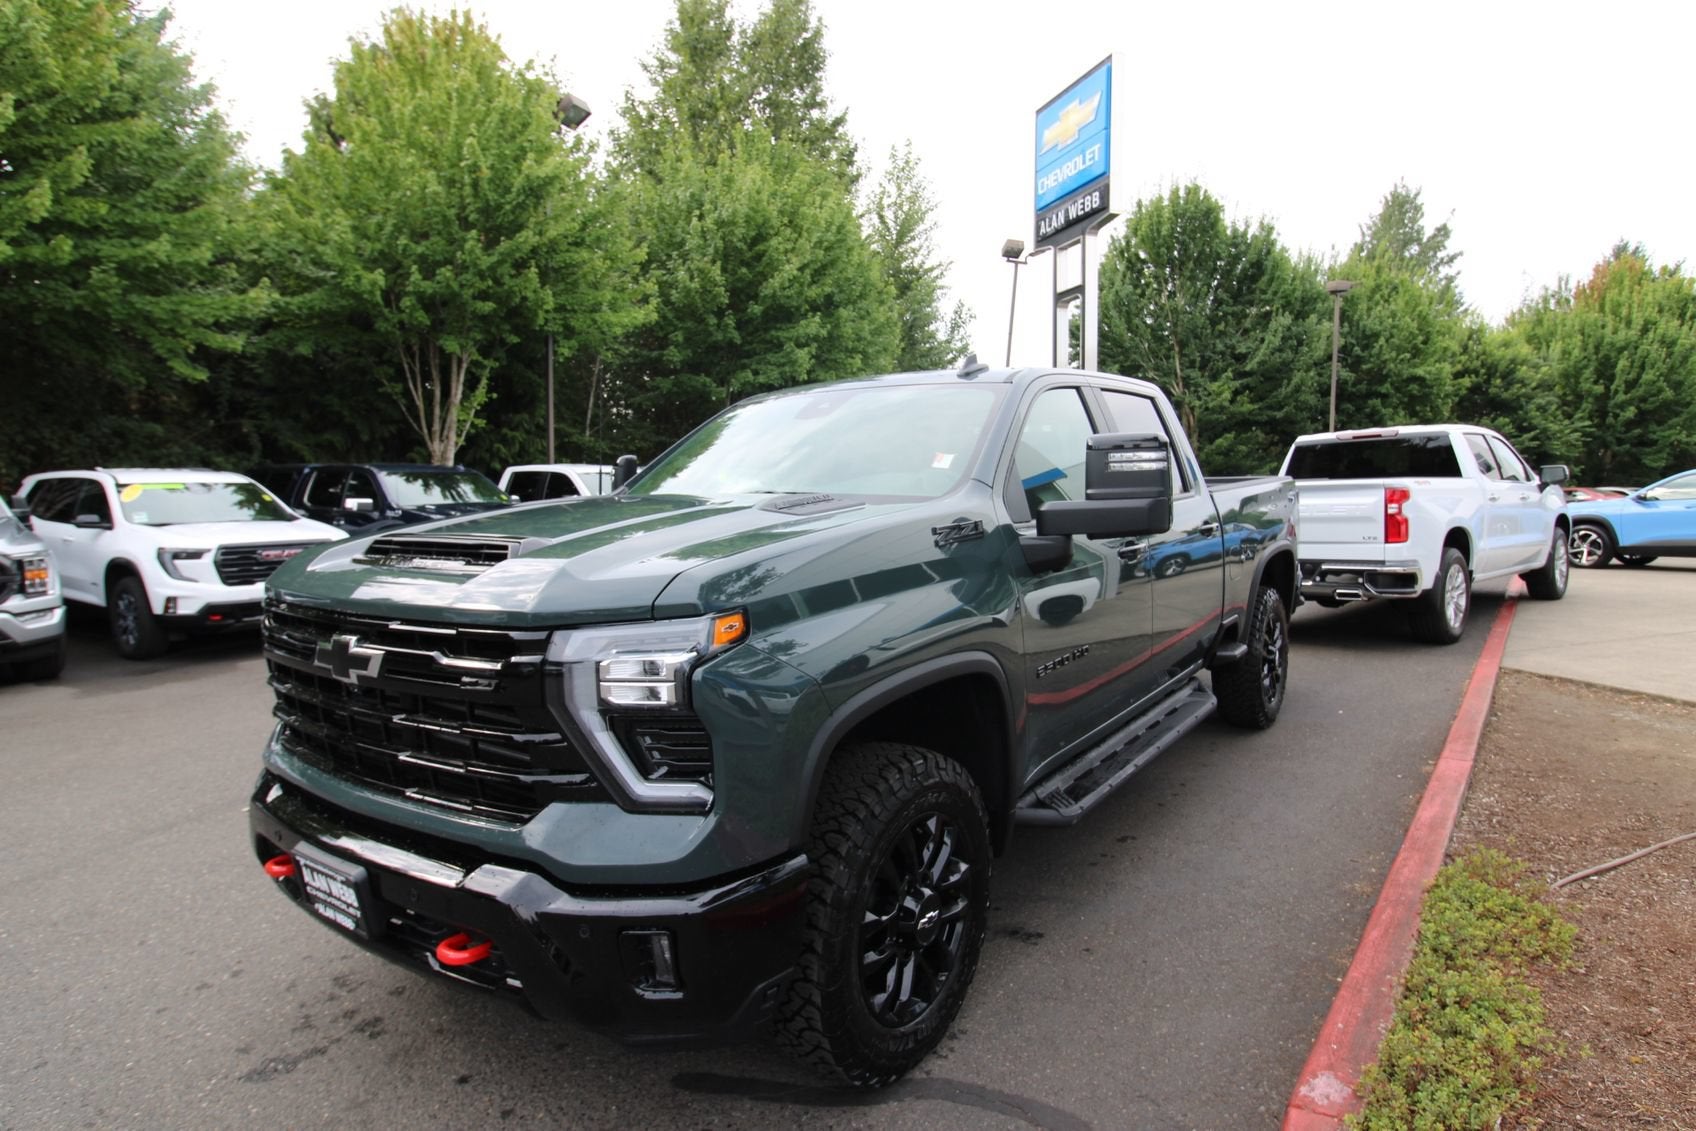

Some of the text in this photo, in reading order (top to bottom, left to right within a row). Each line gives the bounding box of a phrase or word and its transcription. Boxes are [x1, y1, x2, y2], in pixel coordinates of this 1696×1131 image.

[1037, 143, 1101, 195] CHEVROLET
[1039, 191, 1101, 237] ALAN WEBB
